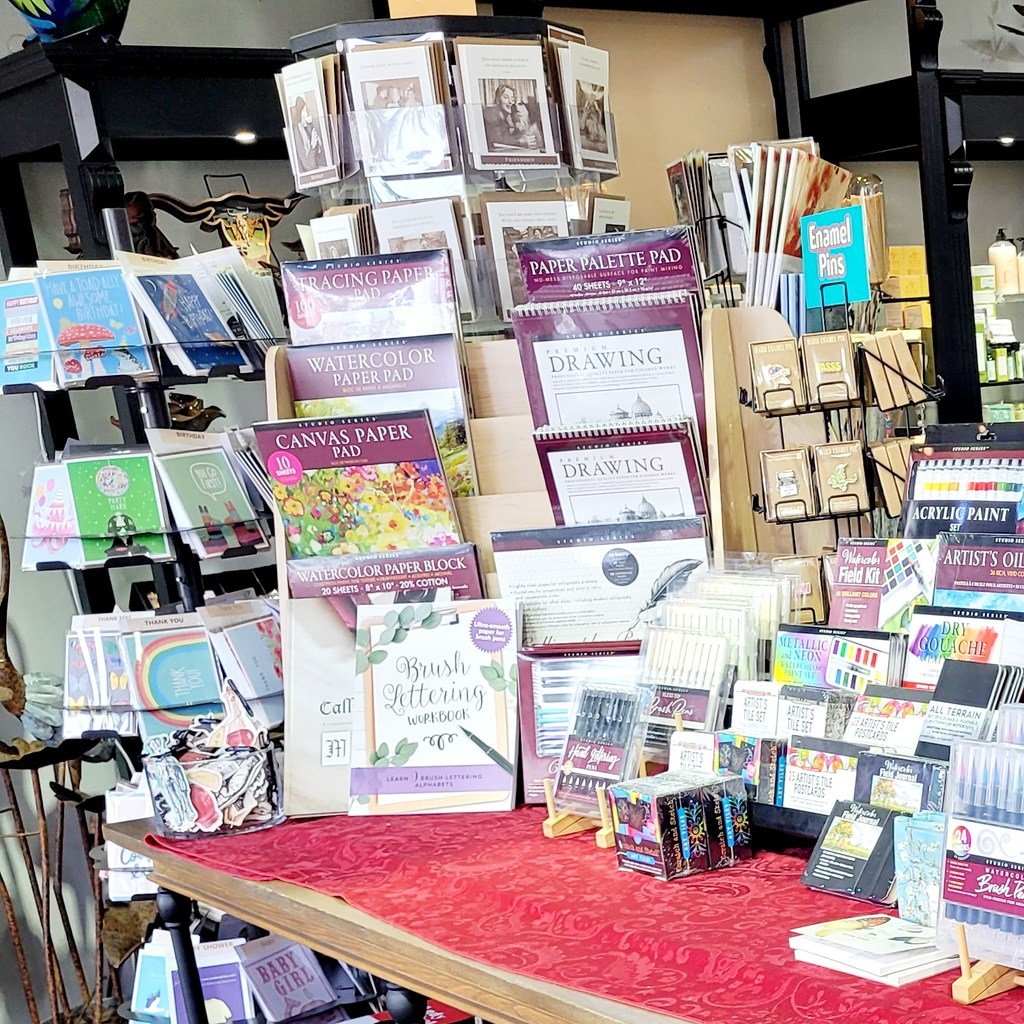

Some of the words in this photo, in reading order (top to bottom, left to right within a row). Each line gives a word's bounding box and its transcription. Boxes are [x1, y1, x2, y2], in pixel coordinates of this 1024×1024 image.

[809, 216, 852, 249] Enamel
[529, 259, 578, 276] PAPER
[580, 251, 646, 272] PALETTE
[650, 248, 682, 265] PAD
[819, 253, 845, 278] Pins
[297, 271, 378, 292] TRACING
[382, 266, 436, 285] PAPER
[599, 270, 625, 278] SURFACE
[661, 264, 683, 272] MIXING
[46, 282, 70, 296] HAVE
[573, 283, 582, 291] 40
[583, 280, 610, 290] SHEETS
[67, 291, 109, 309] AWESOME
[353, 287, 381, 301] PAD
[546, 345, 608, 355] PREMIUM
[5, 363, 19, 371] YOU
[20, 362, 37, 371] ROCK
[307, 348, 436, 373] WATERCOLOR
[548, 348, 663, 374] DRAWING
[333, 370, 381, 387] PAPER
[384, 367, 414, 384] PAD
[176, 431, 205, 440] BIRTHDAY
[276, 429, 350, 450] CANVAS
[356, 424, 412, 443] PAPER
[333, 445, 361, 459] PAD
[276, 456, 291, 468] 10
[563, 457, 665, 478] DRAWING
[912, 506, 965, 522] ACRYLIC
[966, 506, 1010, 522] PAINT
[949, 523, 961, 532] SET
[841, 547, 882, 566] Watercolor
[943, 549, 999, 568] ARTIST'S
[297, 565, 383, 583] WATERCOLOR
[384, 562, 422, 575] PAPER
[424, 558, 467, 571] BLOCK
[838, 566, 863, 583] Field
[865, 568, 879, 584] Kit
[321, 587, 331, 595] 20
[333, 584, 359, 594] SHEETS
[400, 580, 414, 589] 20%
[416, 577, 448, 588] COTTON
[144, 618, 168, 626] THANK
[169, 617, 184, 625] YOU
[940, 621, 969, 637] DRY
[778, 637, 828, 652] METALLIC
[919, 637, 988, 656] GOUACHE
[793, 650, 822, 662] NEON
[396, 650, 471, 684] Brush
[383, 681, 487, 716] Lettering
[743, 697, 768, 709] ARTIST'S
[408, 708, 470, 726] WORKBOOK
[787, 706, 815, 720] ARTIST'S
[929, 705, 945, 716] ALL
[948, 707, 982, 720] TERRAIN
[860, 717, 884, 730] ARTIST'S
[854, 728, 888, 742] POSTCARDS
[446, 773, 483, 781] LETTERING
[796, 772, 819, 785] ARTIST'S
[793, 782, 826, 798] POSTCARDS
[955, 830, 968, 844] 24
[985, 859, 1008, 868] STUDIO
[975, 874, 1010, 897] Brush
[255, 951, 298, 984] BABY
[273, 968, 314, 997] GIRL
